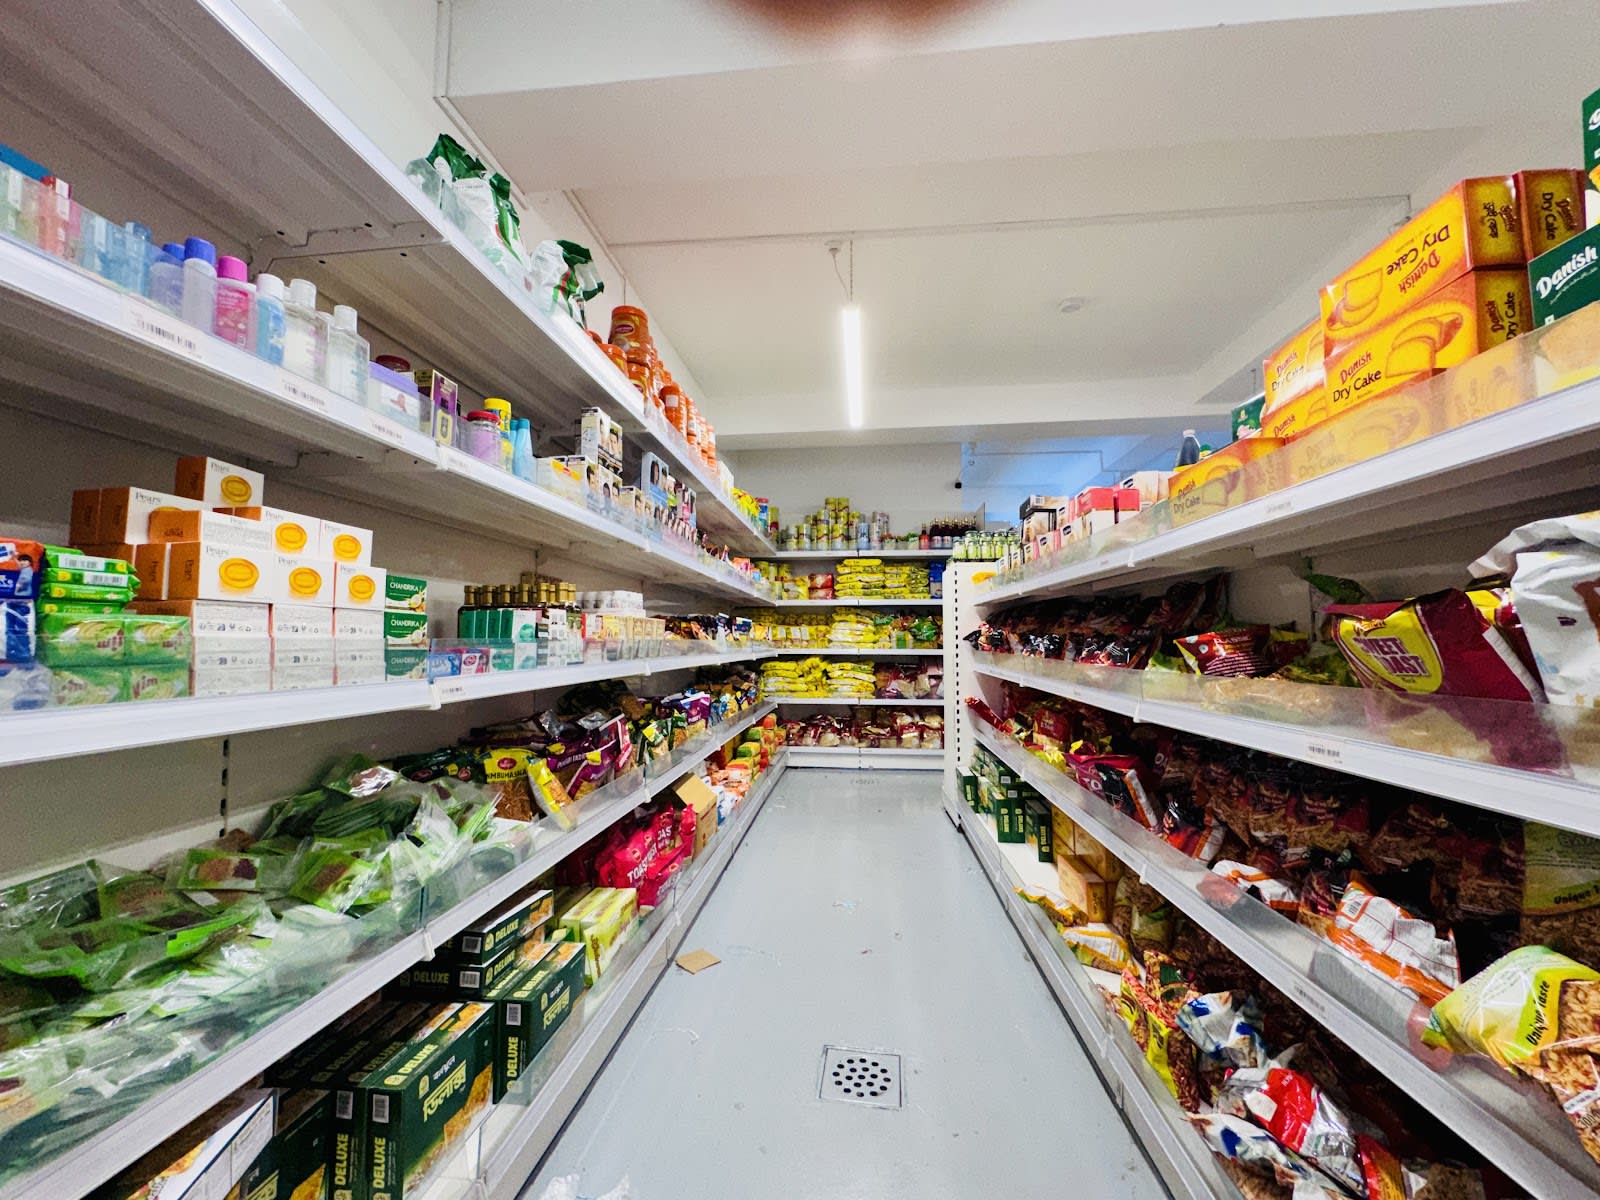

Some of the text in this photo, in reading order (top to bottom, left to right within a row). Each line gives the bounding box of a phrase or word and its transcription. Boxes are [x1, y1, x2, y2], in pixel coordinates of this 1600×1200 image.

[1541, 192, 1557, 240] Dry Cake
[1386, 225, 1451, 275] Dry Cake
[1399, 249, 1441, 294] Danish
[1536, 246, 1599, 299] Danish
[1505, 291, 1516, 317] Cake
[1276, 351, 1298, 377] Danish
[1340, 352, 1372, 384] Danish
[1271, 377, 1285, 392] Dry
[1333, 386, 1351, 403] Dry
[1353, 369, 1382, 391] Cake
[1273, 414, 1297, 437] Danish
[389, 581, 419, 592] CHANDRIKA
[390, 619, 420, 627] CHANDRIKA
[1352, 635, 1409, 656] SWEET
[494, 918, 519, 943] DELUXE
[413, 972, 449, 984] DELUXE
[493, 949, 516, 977] DELUXE
[1526, 1006, 1550, 1046] Unique
[398, 1043, 439, 1074] DELUXE
[507, 1036, 519, 1077] DELUXE
[335, 1133, 349, 1186] DELUXE
[373, 1137, 387, 1189] DELUXE
